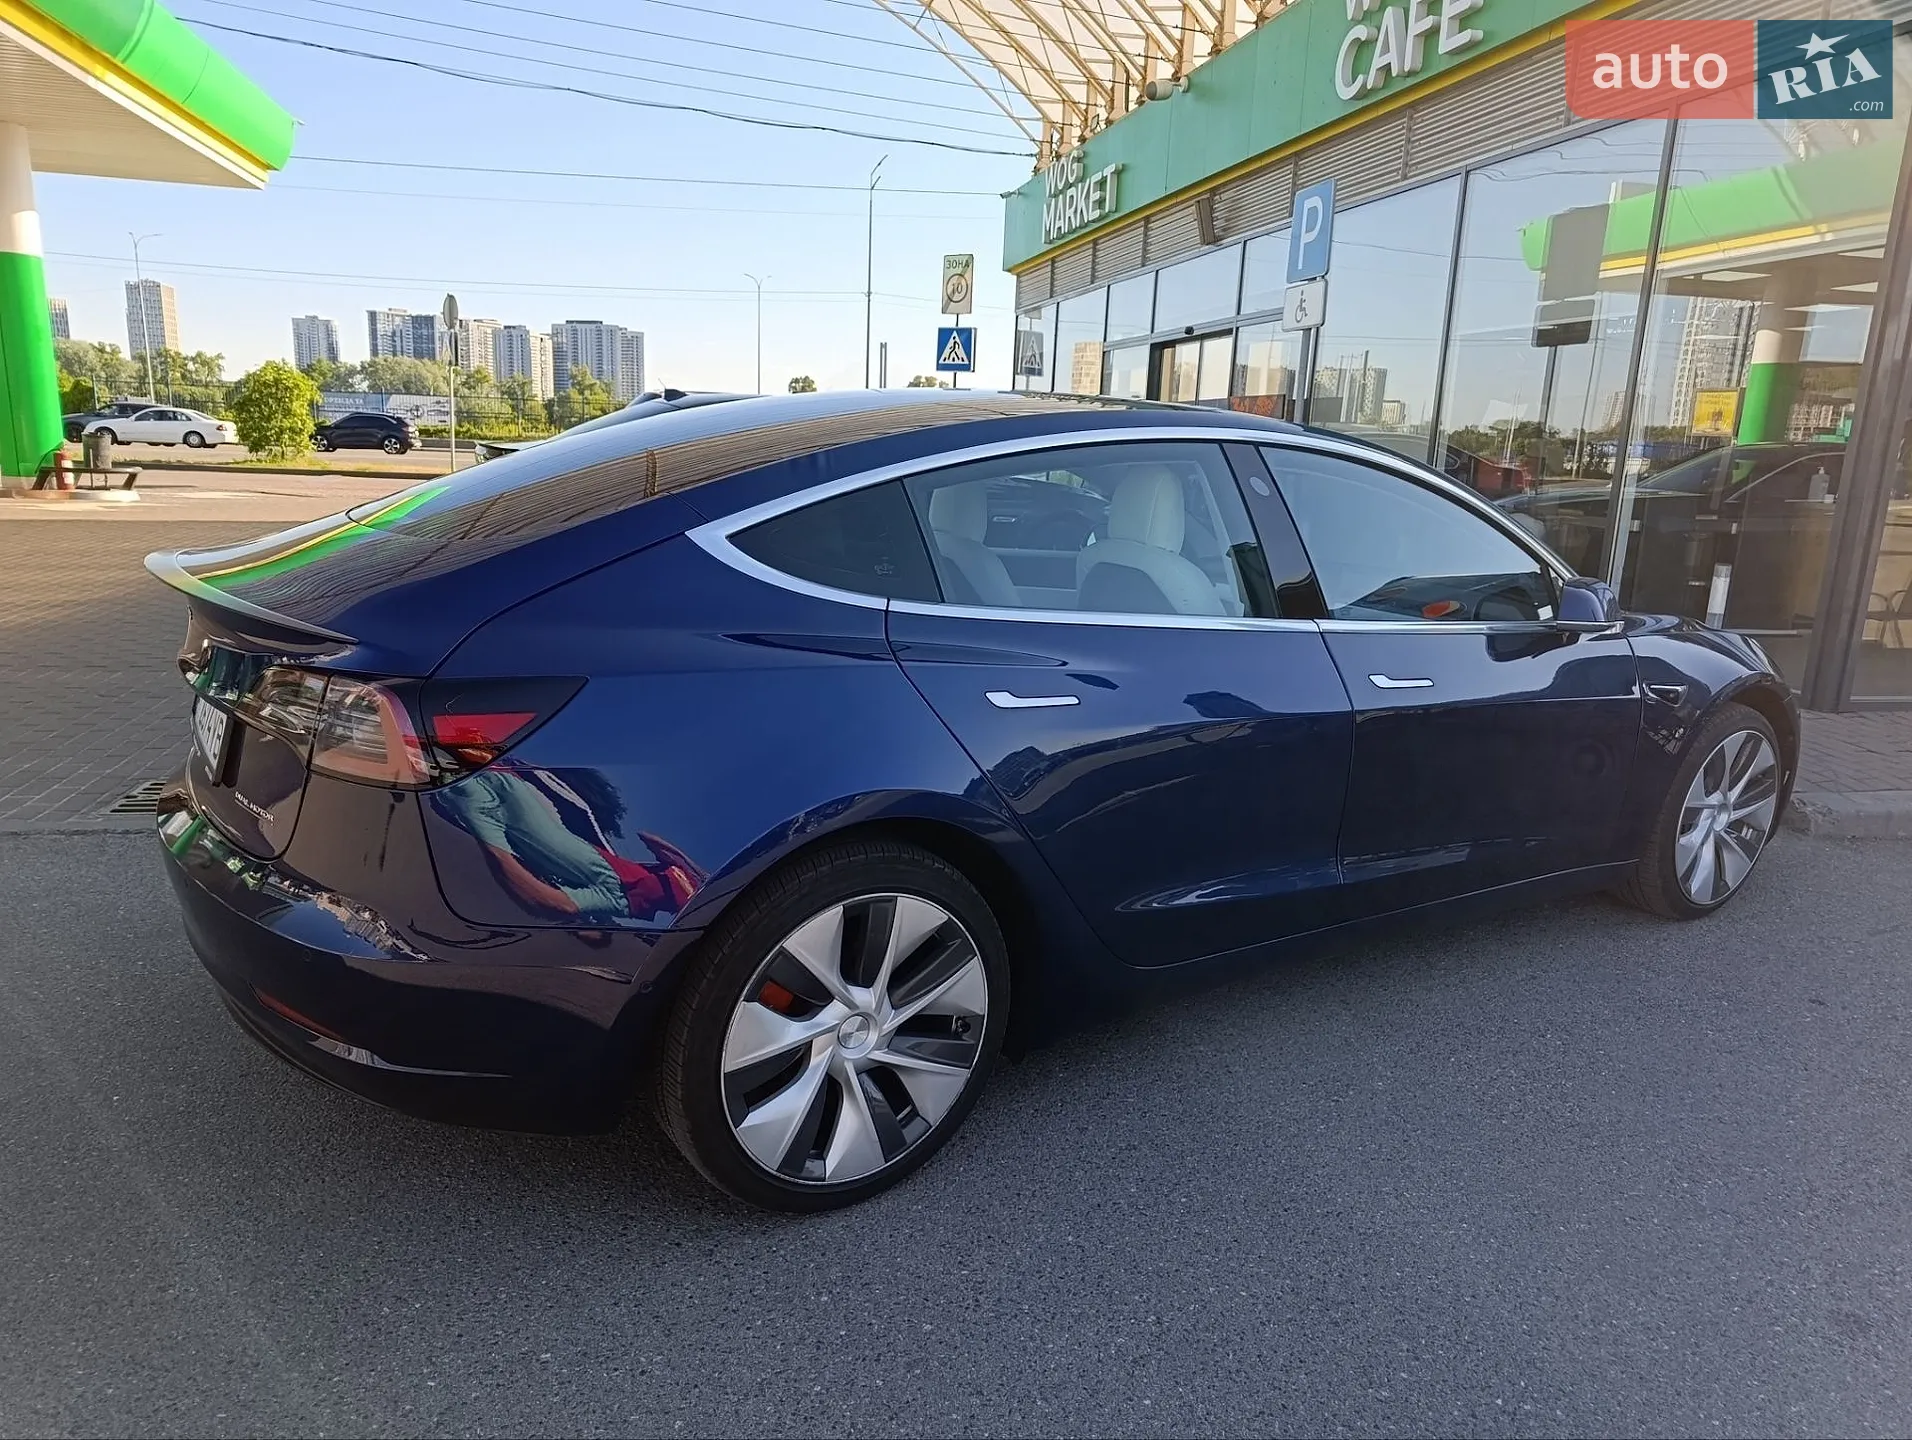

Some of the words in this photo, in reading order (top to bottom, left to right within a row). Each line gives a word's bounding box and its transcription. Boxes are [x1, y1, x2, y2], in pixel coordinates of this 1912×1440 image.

[1335, 0, 1481, 100] CAFE
[1042, 163, 1121, 244] MARKET
[1045, 150, 1083, 198] WOG
[946, 259, 970, 269] ЗОНА
[1298, 196, 1323, 269] P
